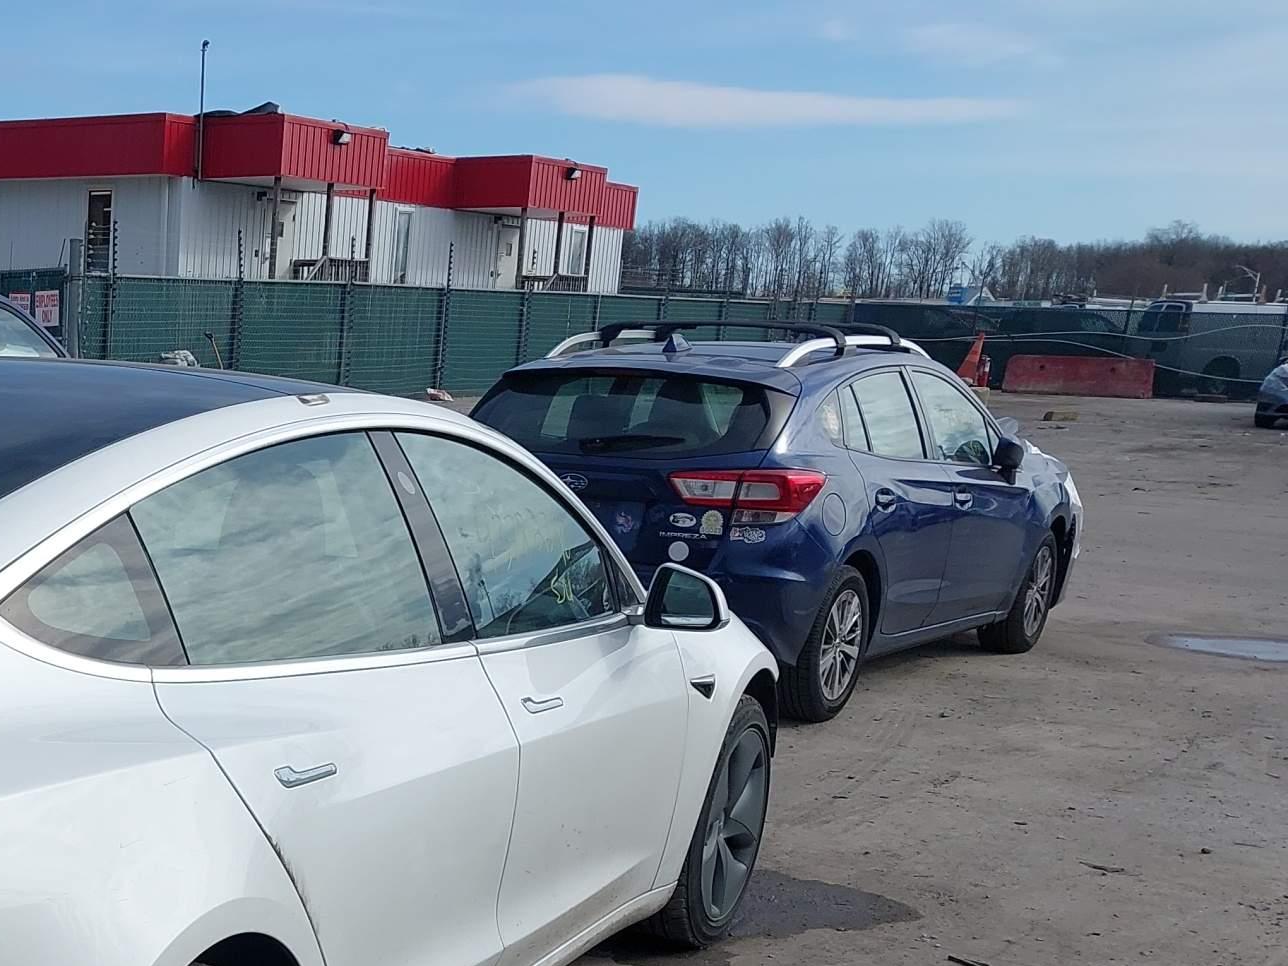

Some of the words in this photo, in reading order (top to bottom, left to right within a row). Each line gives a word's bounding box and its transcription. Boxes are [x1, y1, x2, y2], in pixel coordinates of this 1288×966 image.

[36, 294, 58, 308] EMPLOYEES
[42, 309, 52, 323] ONLY
[659, 531, 707, 539] IMPREZA
